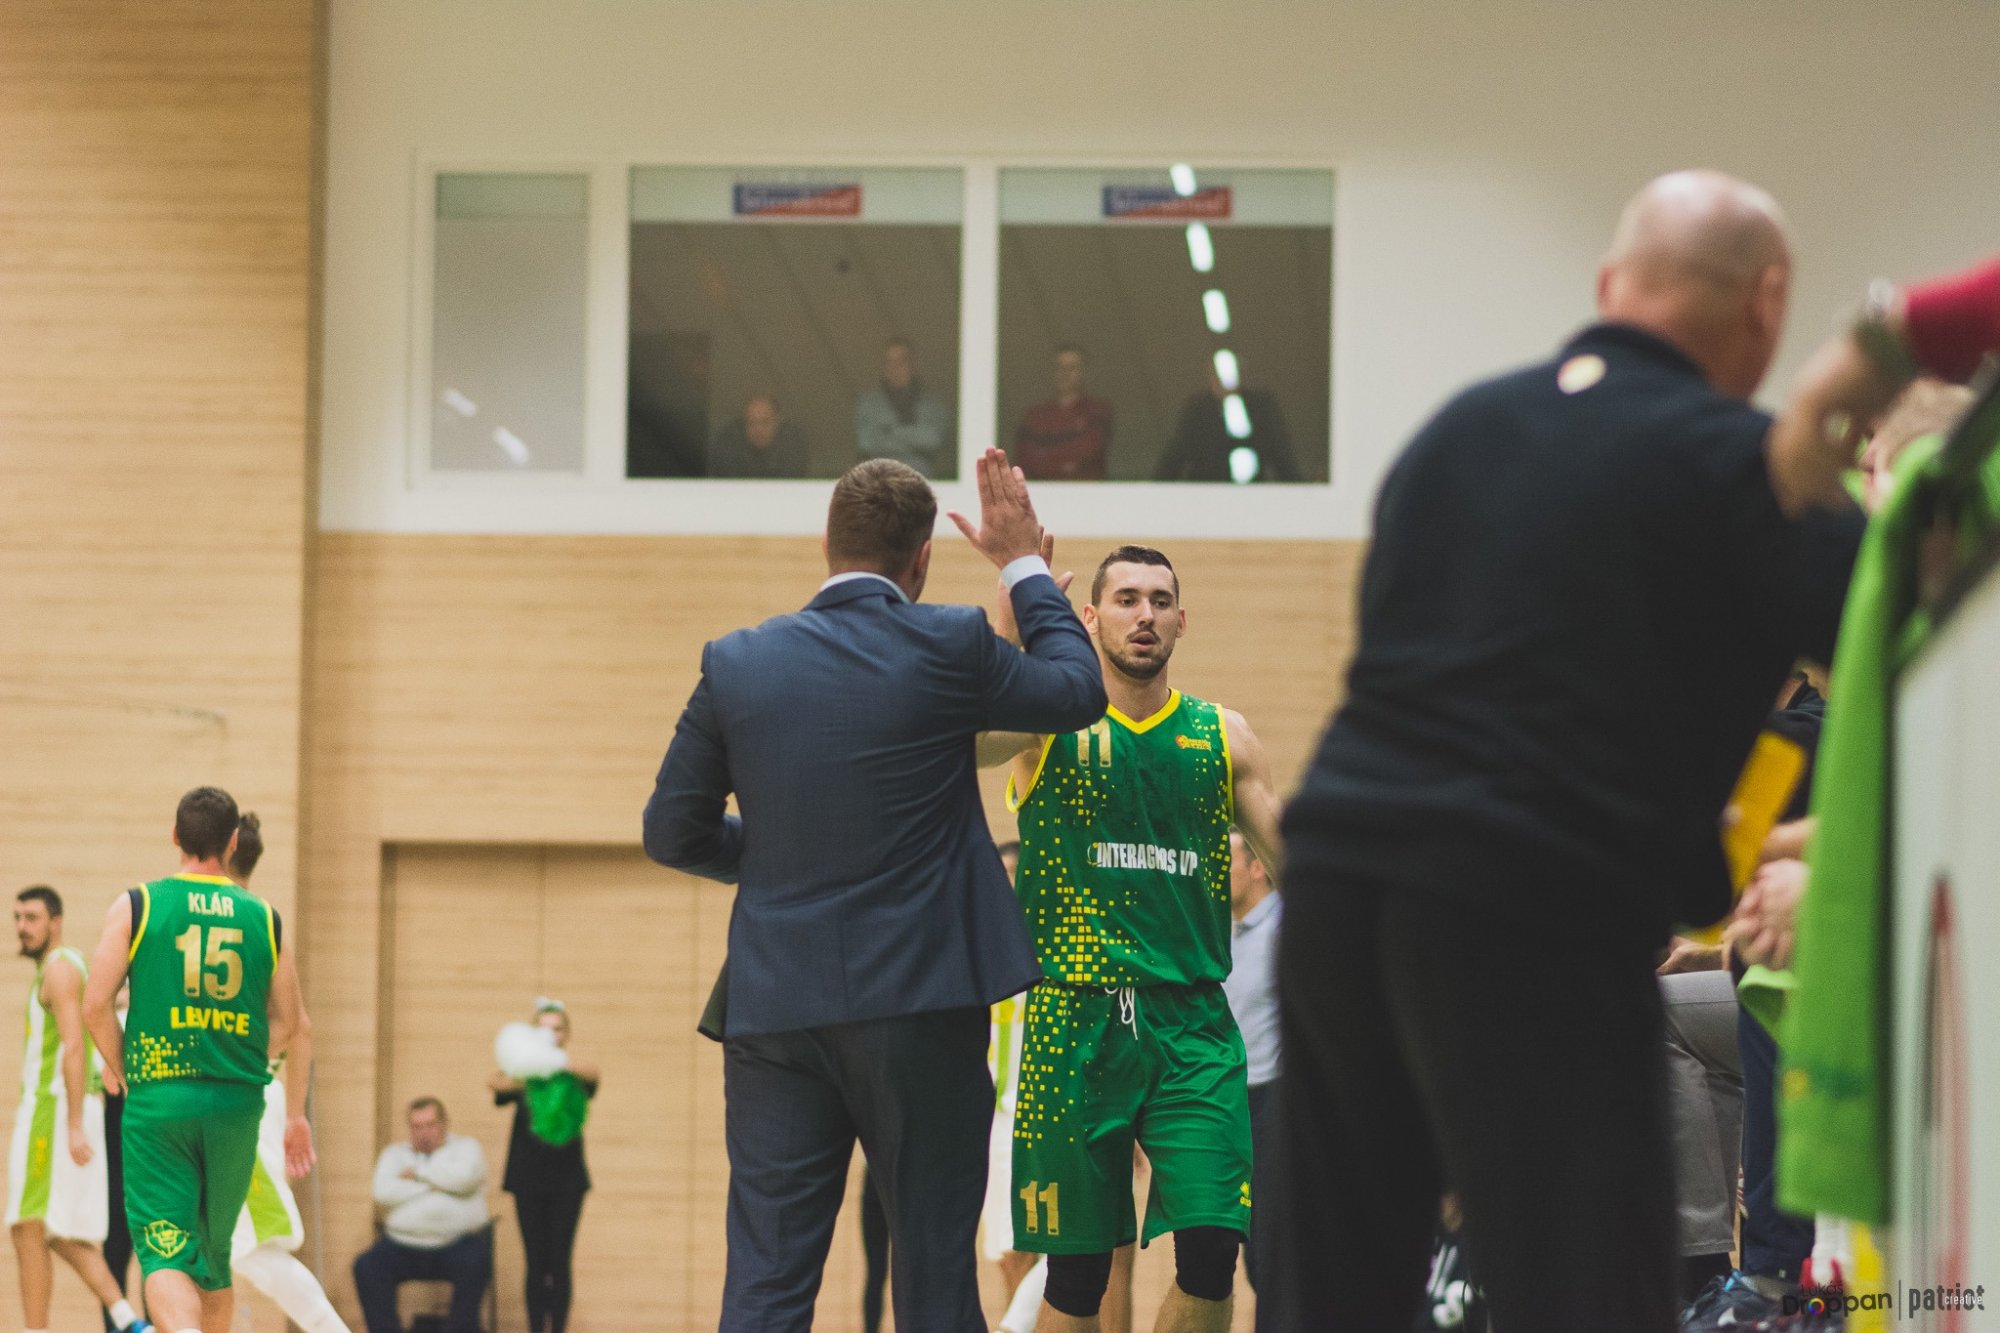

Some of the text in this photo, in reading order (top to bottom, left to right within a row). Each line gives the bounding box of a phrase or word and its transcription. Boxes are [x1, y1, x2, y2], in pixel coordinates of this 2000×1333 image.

[1075, 717, 1111, 768] 11
[1180, 850, 1198, 877] VP
[187, 891, 235, 918] KLÁR
[175, 924, 243, 1001] 15
[170, 1005, 250, 1036] LEVICE
[1020, 1180, 1059, 1235] 11
